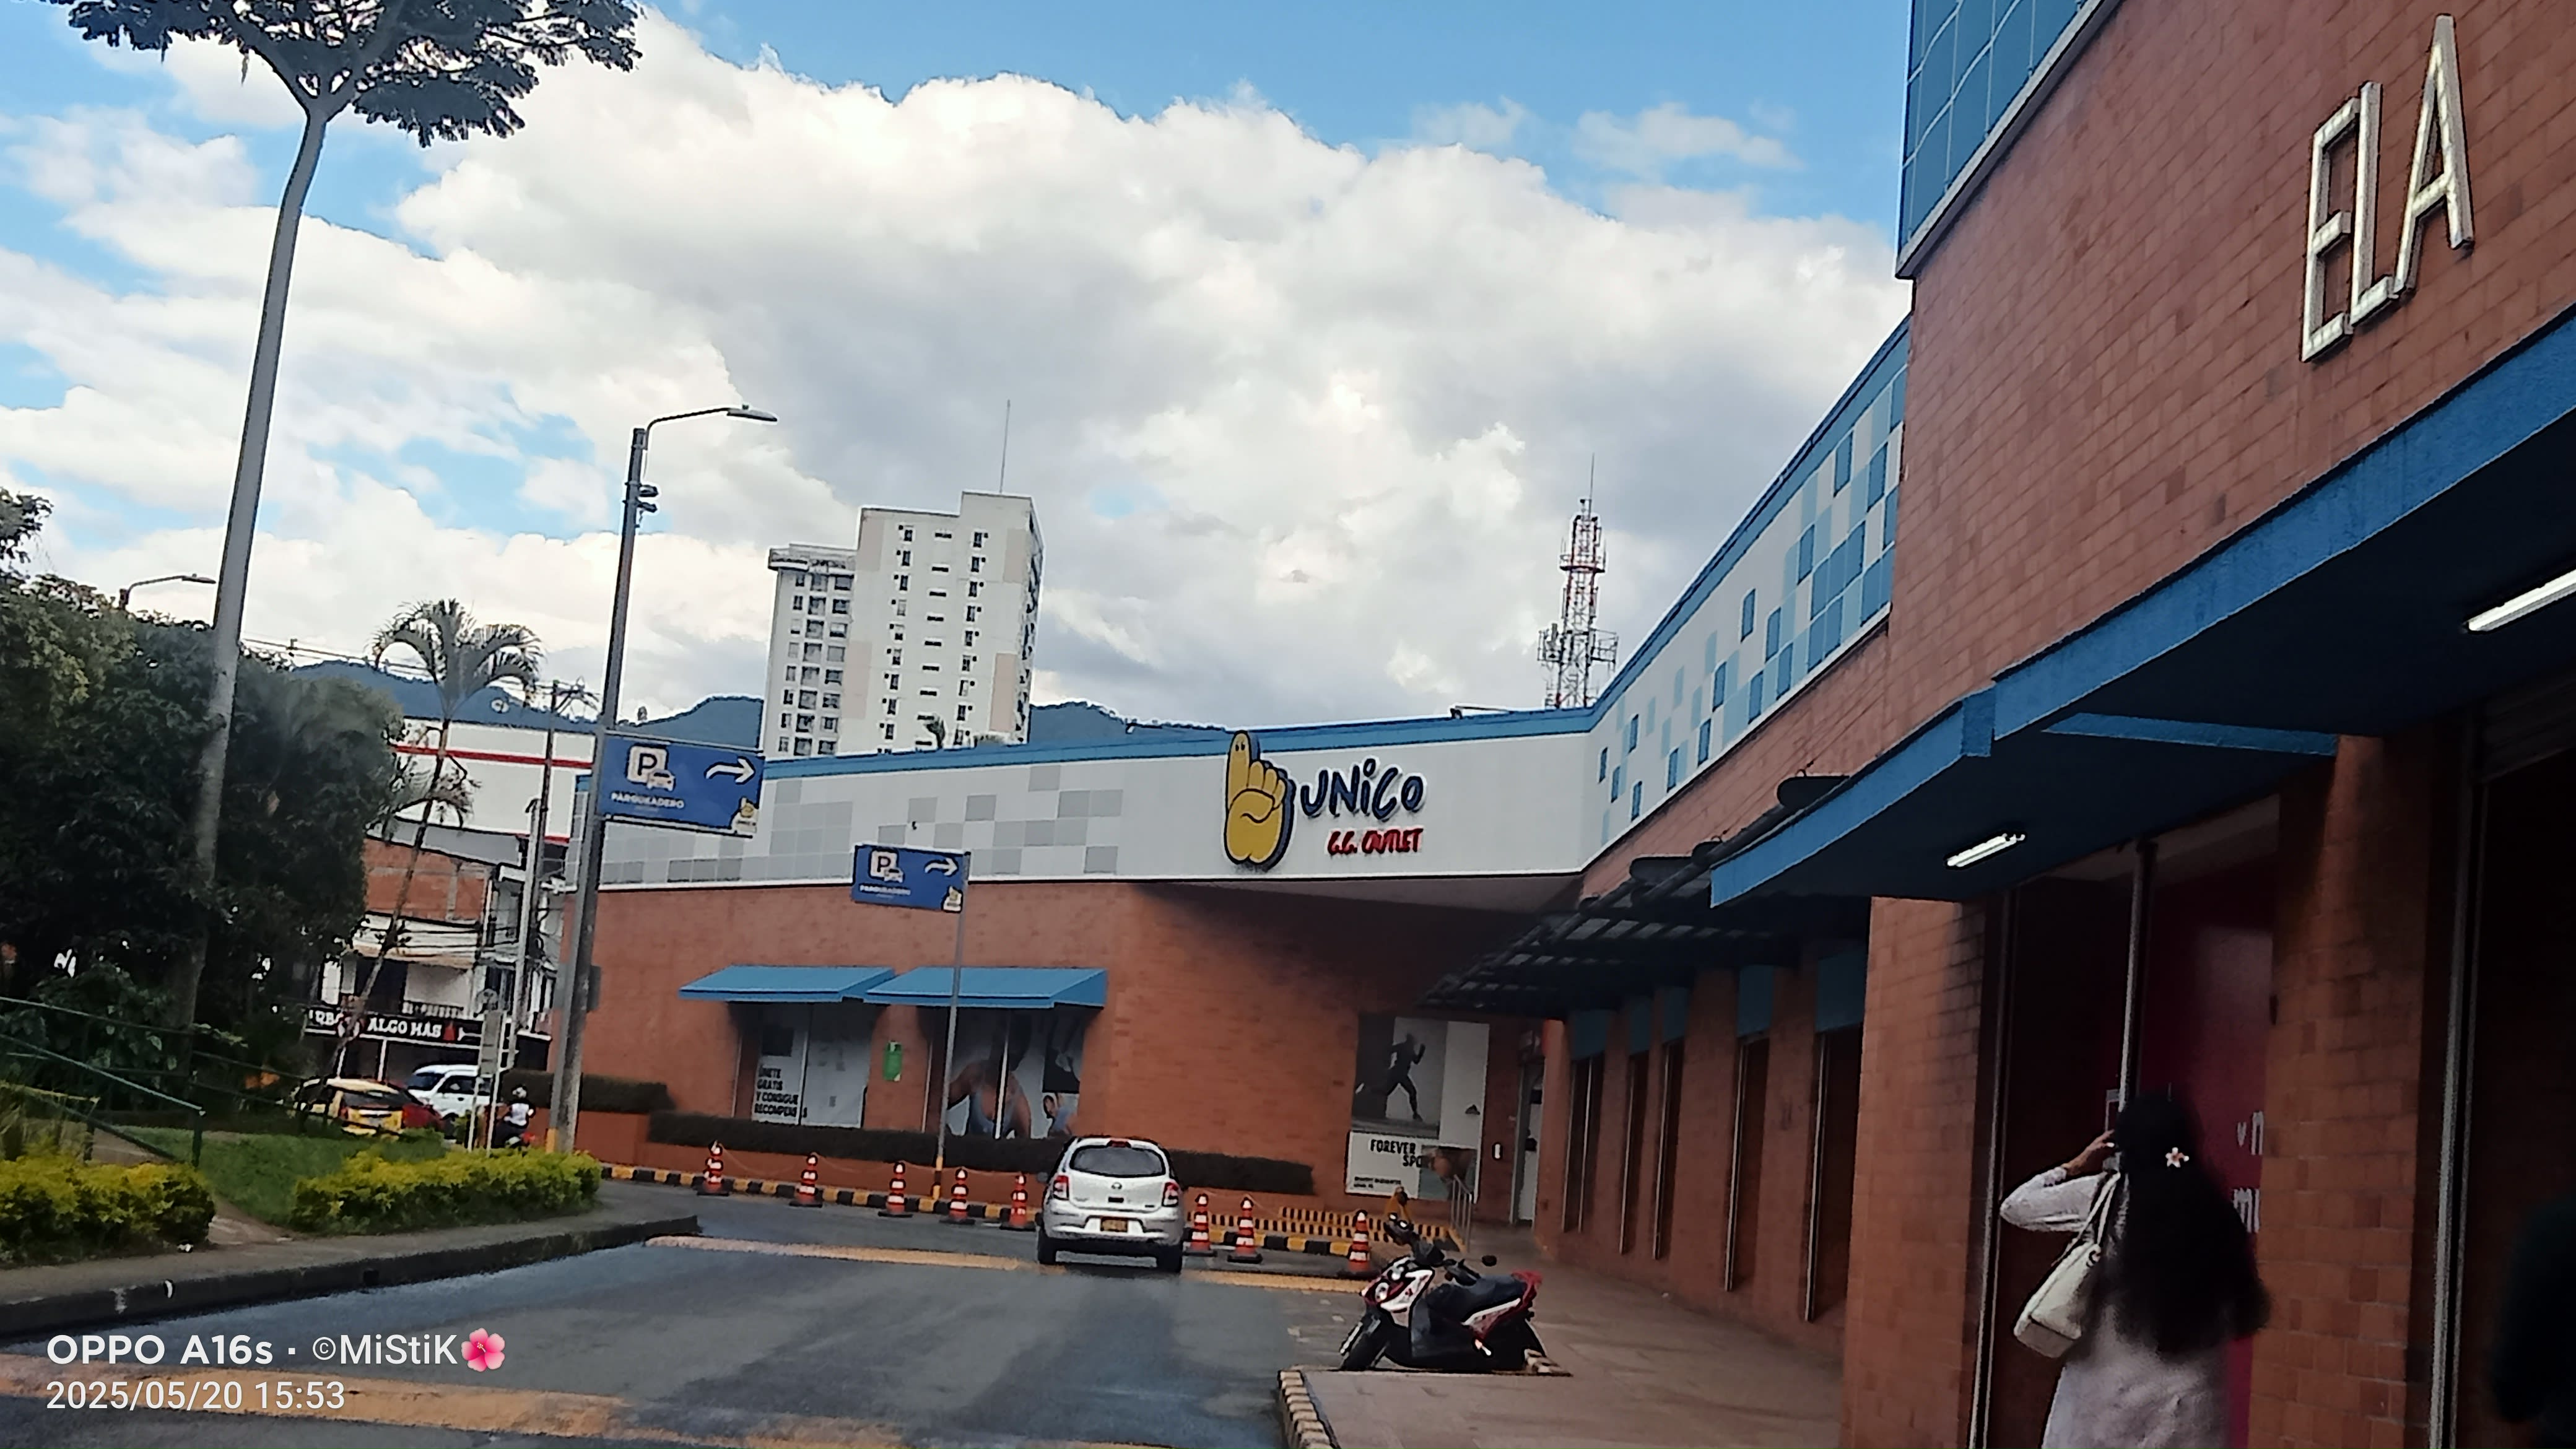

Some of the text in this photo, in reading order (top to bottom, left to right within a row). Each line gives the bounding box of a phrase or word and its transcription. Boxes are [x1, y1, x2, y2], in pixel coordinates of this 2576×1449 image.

[1362, 828, 1424, 854] OUTLET
[367, 1017, 408, 1034] ALGO
[756, 1091, 799, 1105] Y CONSIGUE
[754, 1103, 807, 1118] RECOMPENSS
[1370, 1139, 1416, 1154] FOREVER
